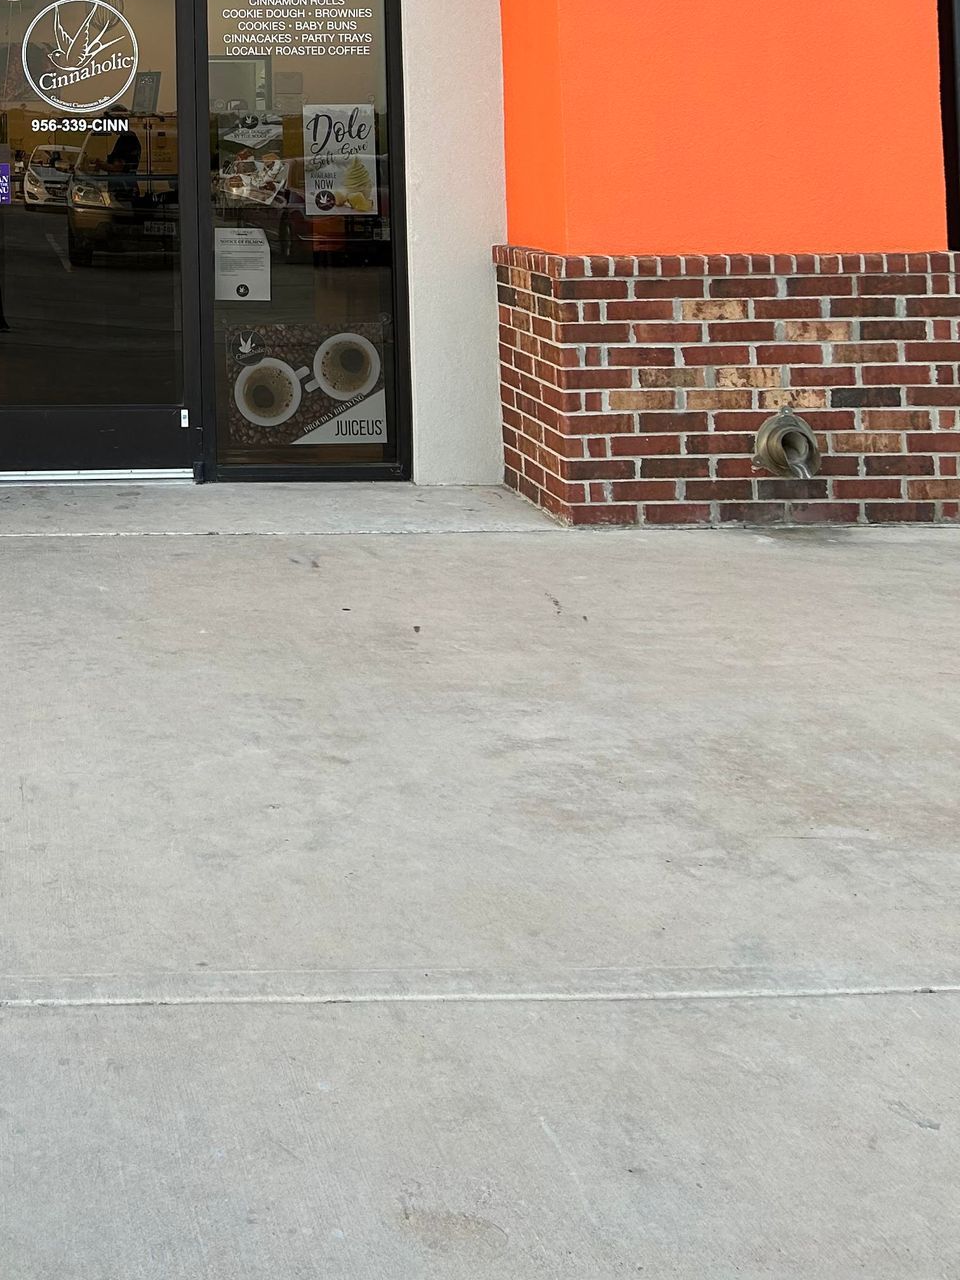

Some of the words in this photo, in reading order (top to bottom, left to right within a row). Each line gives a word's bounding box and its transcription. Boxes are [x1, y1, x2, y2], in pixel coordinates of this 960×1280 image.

[222, 9, 263, 19] COOKIE
[266, 9, 305, 18] DOUGH
[315, 8, 373, 18] BROWNIES
[238, 22, 286, 31] COOKIES
[295, 21, 324, 30] BABY
[327, 21, 357, 30] BUNS
[223, 34, 292, 43] CINNACAKES
[301, 33, 335, 43] PARTY
[338, 33, 372, 43] TRAYS
[226, 46, 273, 56] LOCALLY
[276, 46, 326, 55] ROASTED
[328, 46, 370, 55] COFFEE
[40, 52, 132, 91] Cinnaholic
[31, 118, 129, 132] 956-339-CINN
[306, 107, 373, 154] Dole
[315, 179, 334, 189] NOW
[335, 419, 383, 436] JUICEUS
